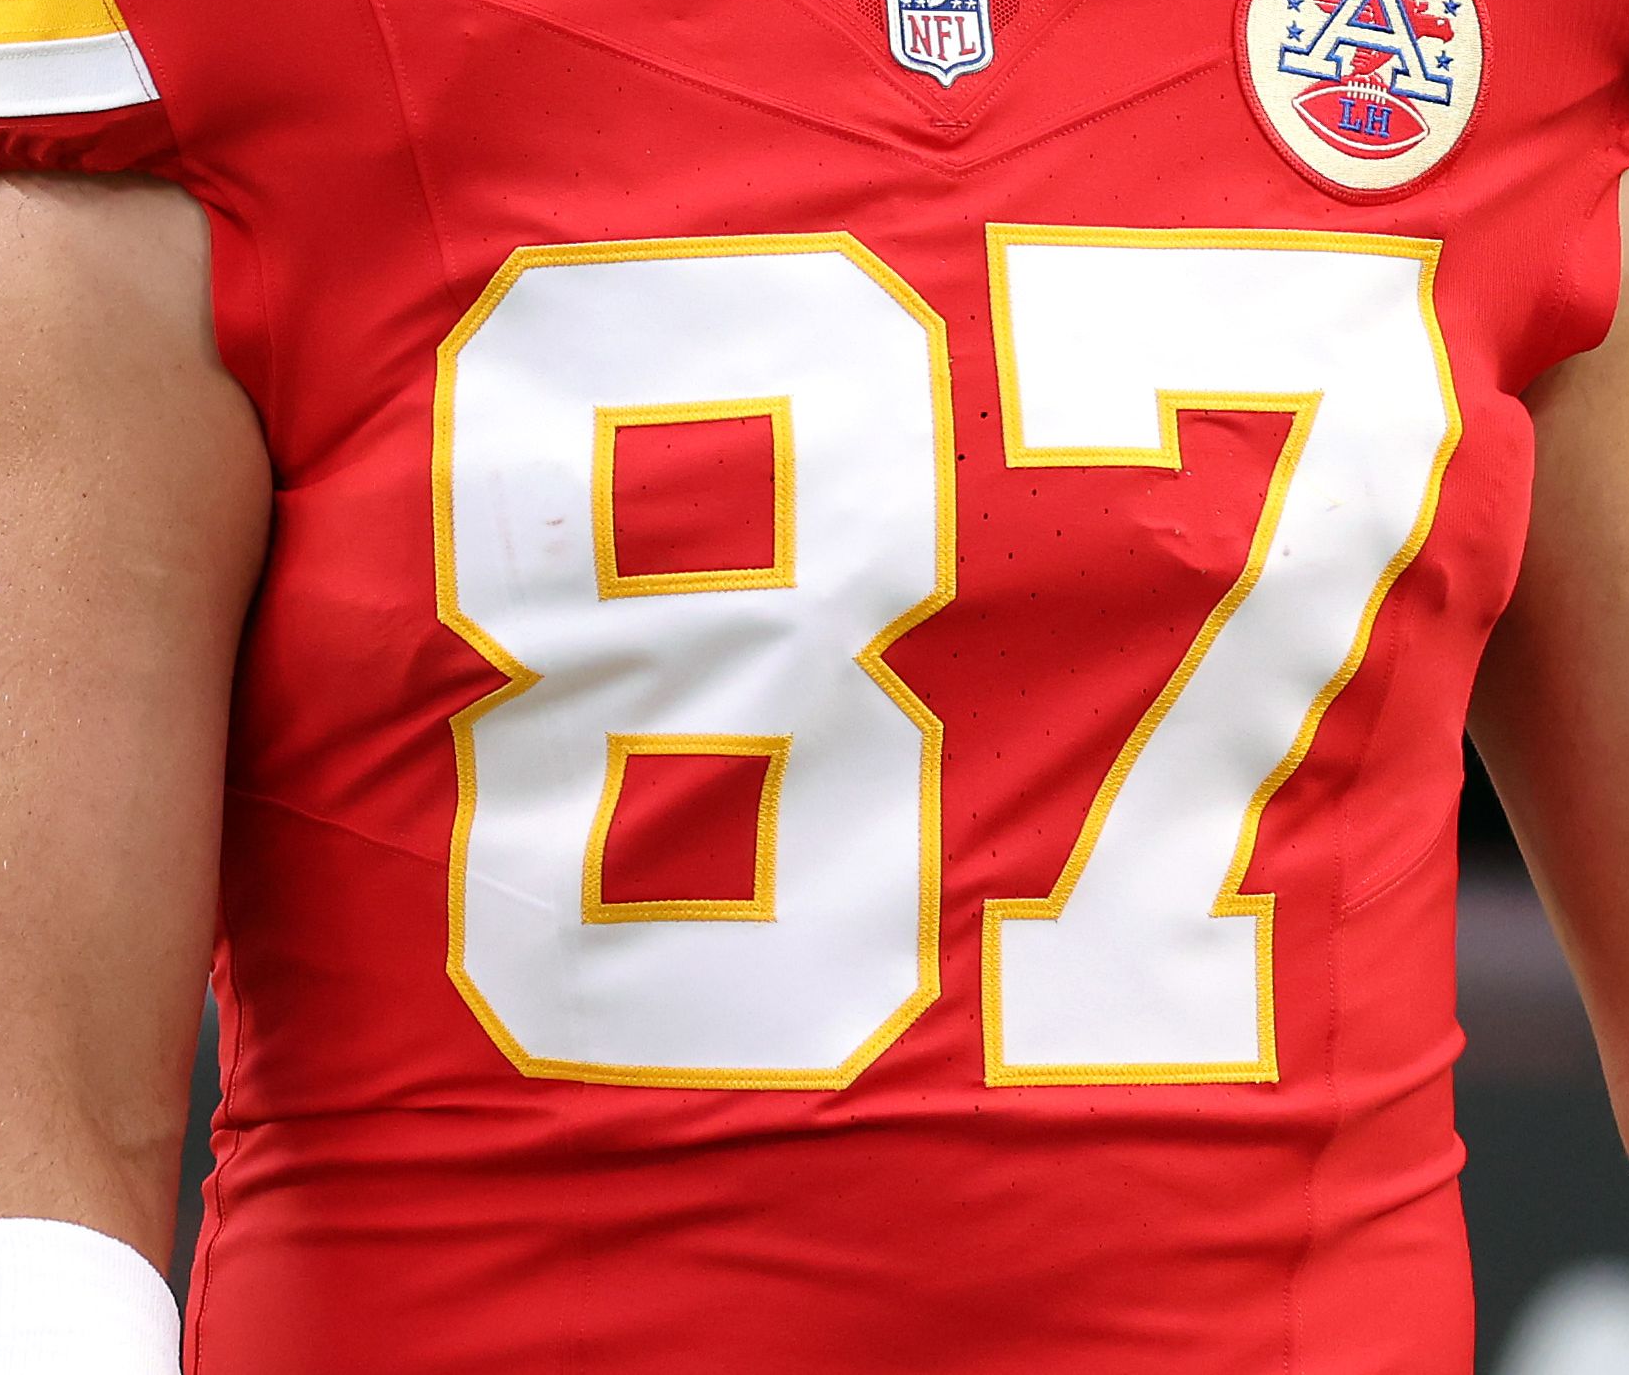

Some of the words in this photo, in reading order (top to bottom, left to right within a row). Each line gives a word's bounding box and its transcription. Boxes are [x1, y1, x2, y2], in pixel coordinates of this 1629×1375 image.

[907, 14, 977, 62] NFL
[1337, 97, 1393, 139] LH
[431, 222, 1463, 1090] 87
